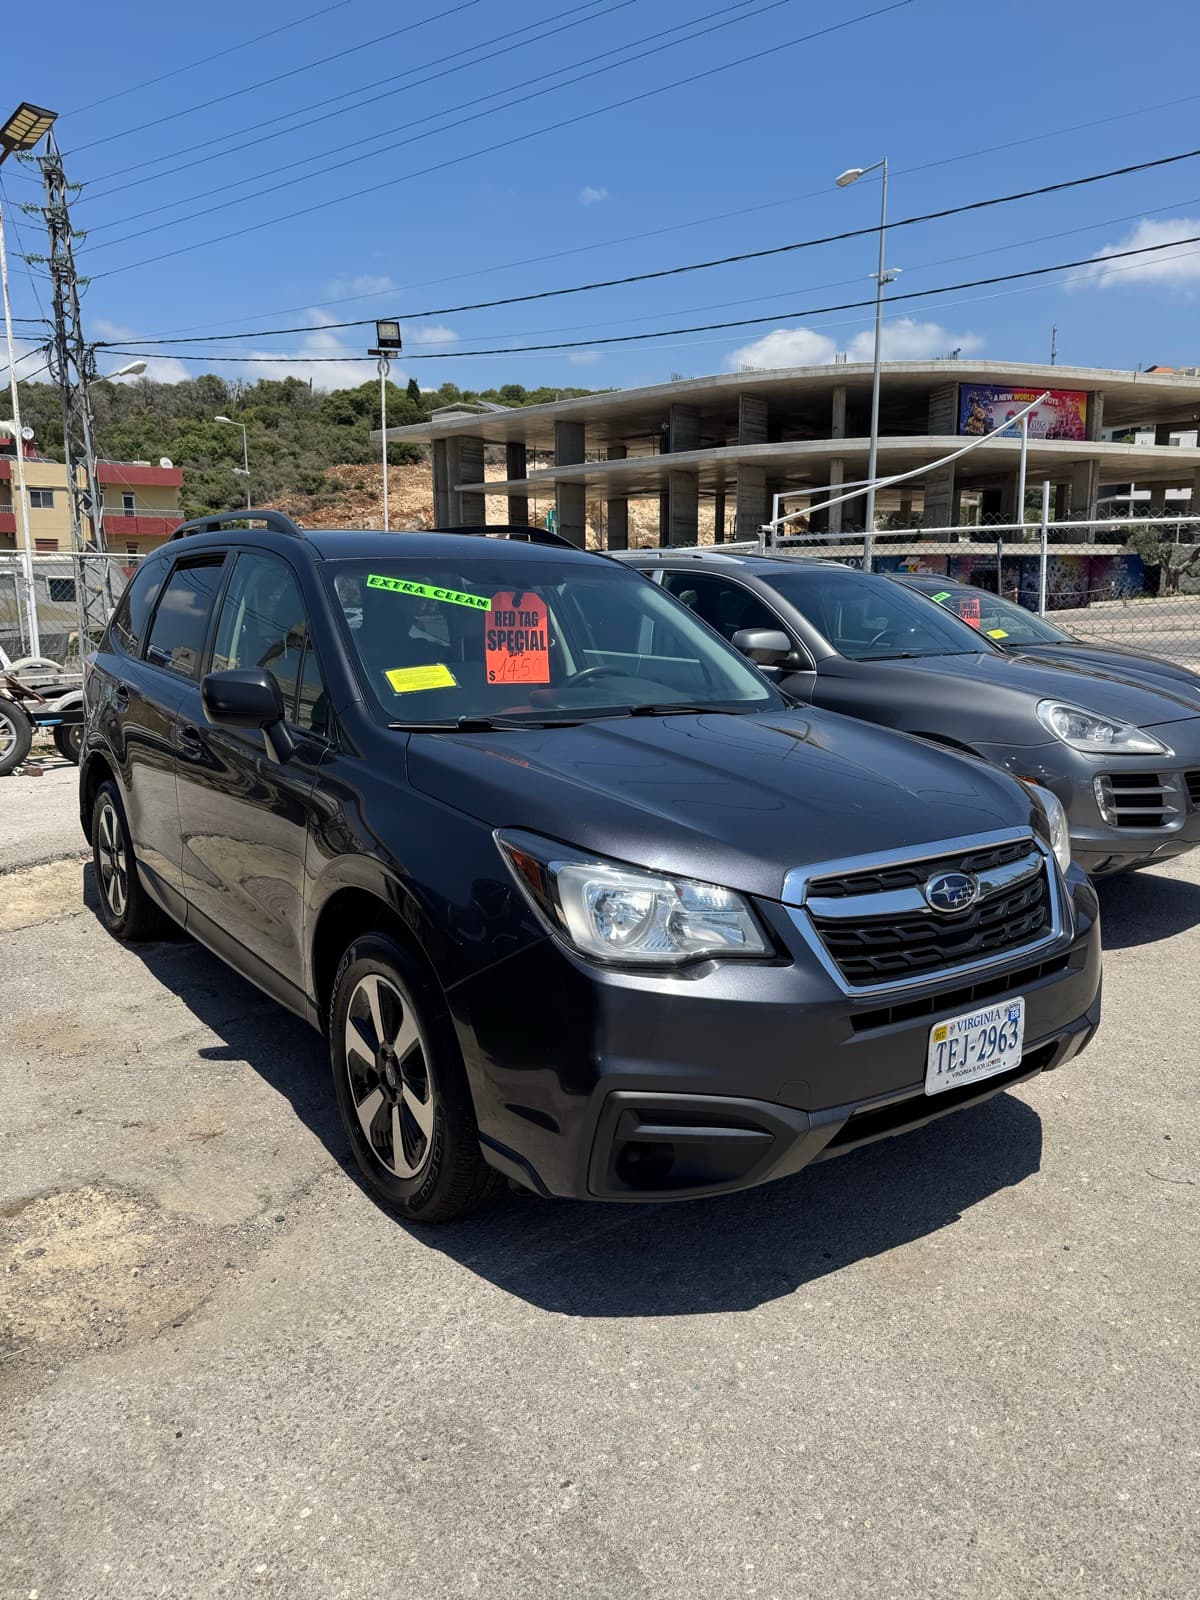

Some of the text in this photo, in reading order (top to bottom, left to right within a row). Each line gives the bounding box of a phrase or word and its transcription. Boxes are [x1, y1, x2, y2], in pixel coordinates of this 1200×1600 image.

[369, 577, 488, 608] EXTRA CLEAN
[495, 611, 538, 627] RED TAG
[487, 629, 546, 651] SPECIAL
[489, 670, 496, 681] $
[957, 1009, 1001, 1032] VIRGINIA
[936, 1019, 1019, 1075] TEJ-2963
